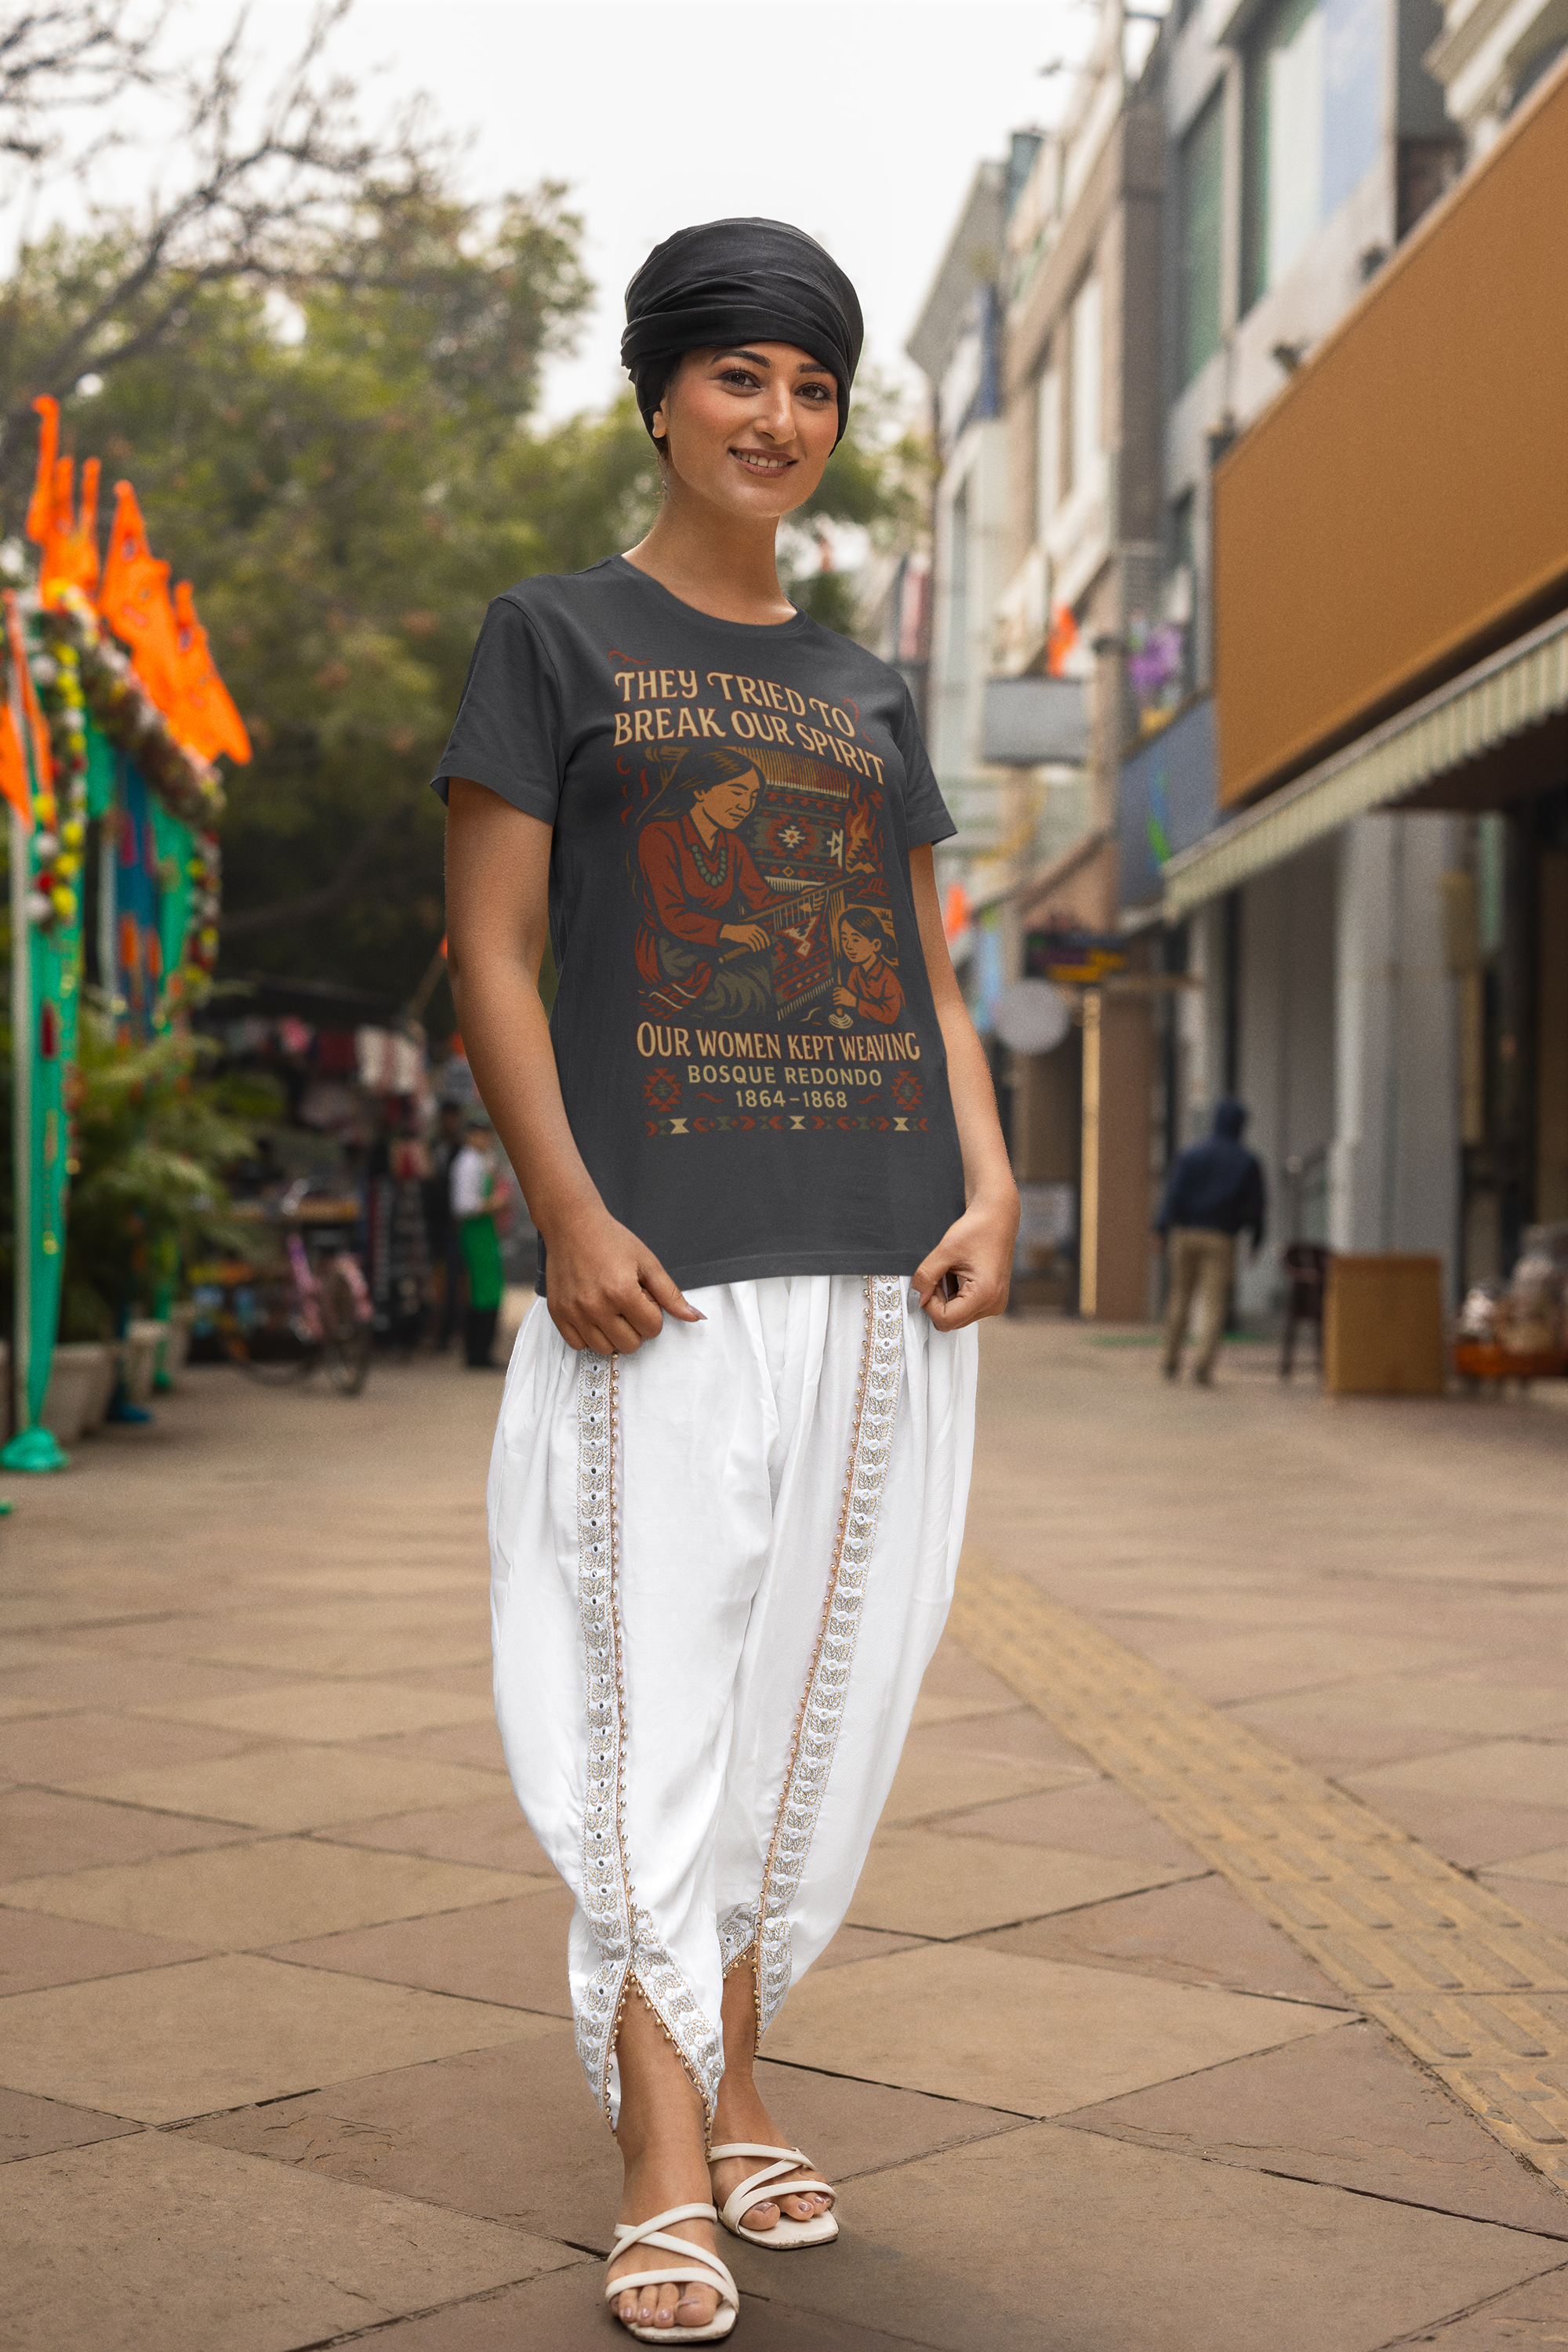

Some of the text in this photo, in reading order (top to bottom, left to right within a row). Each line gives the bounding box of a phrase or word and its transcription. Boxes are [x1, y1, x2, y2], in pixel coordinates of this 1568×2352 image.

[614, 669, 856, 738] THEY TRIED TO
[613, 706, 886, 786] BREAK OUR SPIRIT
[637, 1021, 920, 1062] OUR WOMEN KEPT WEAVING
[688, 1065, 882, 1086] BOSQUE REDONDO
